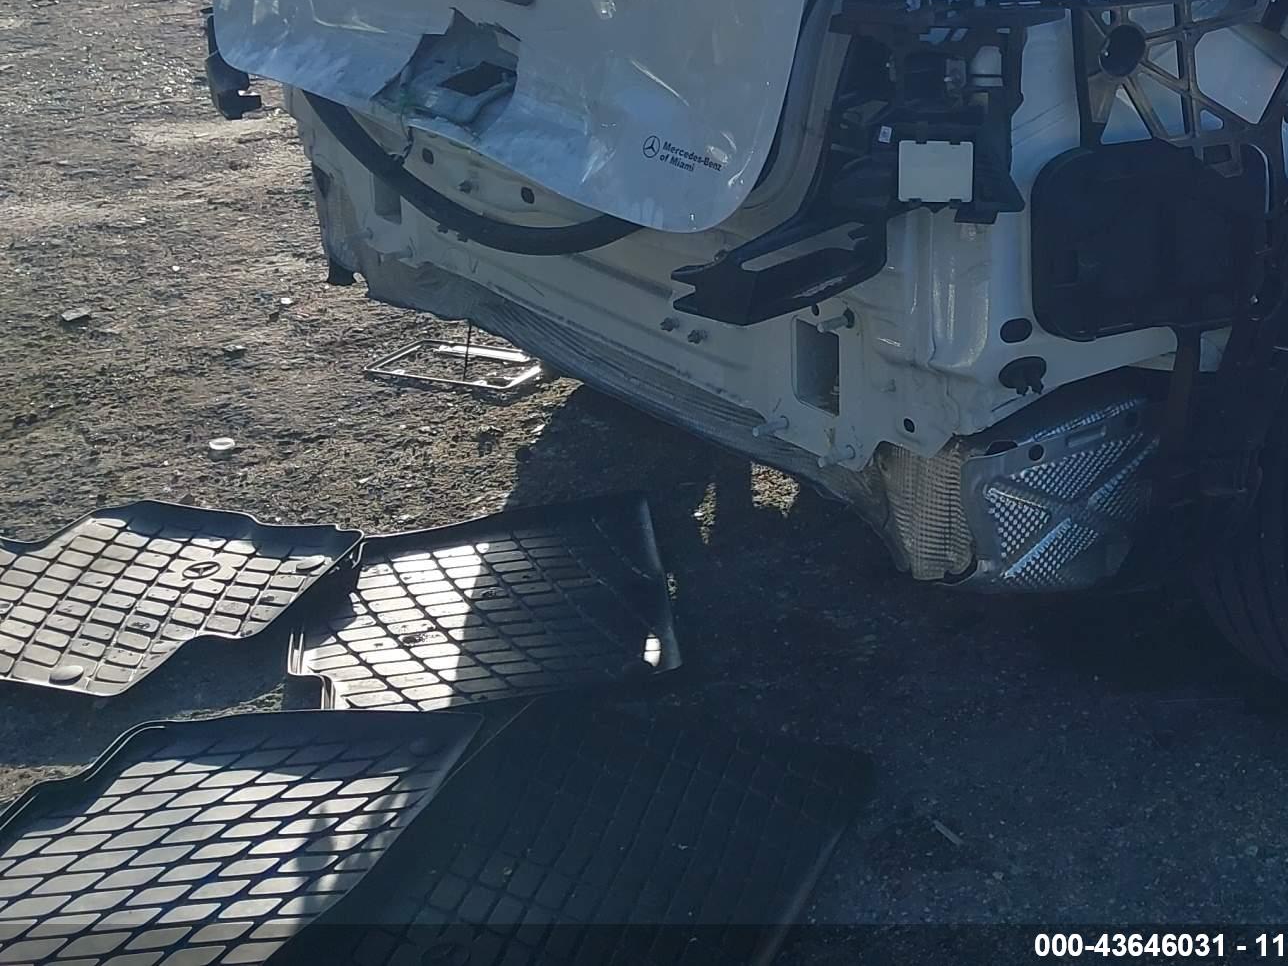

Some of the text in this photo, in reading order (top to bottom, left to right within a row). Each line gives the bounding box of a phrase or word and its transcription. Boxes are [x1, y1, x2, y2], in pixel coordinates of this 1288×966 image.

[659, 153, 695, 172] of Miami
[662, 141, 722, 172] Mercedes-Benz
